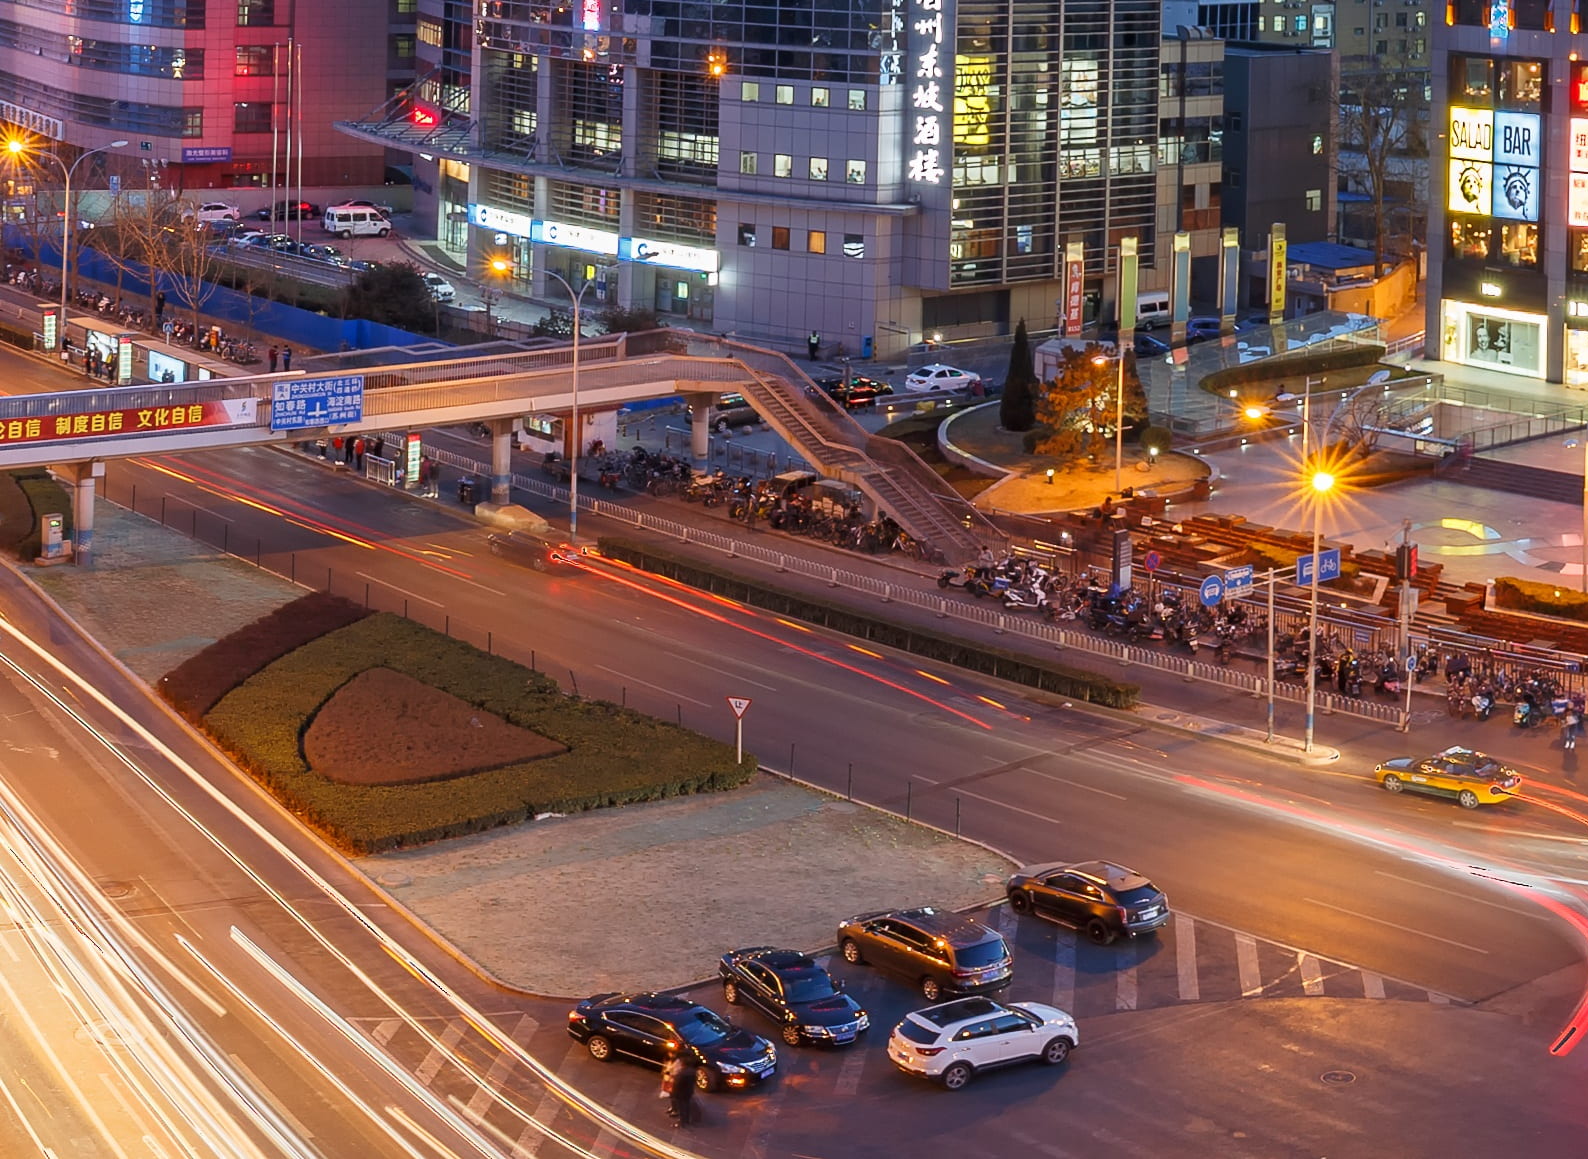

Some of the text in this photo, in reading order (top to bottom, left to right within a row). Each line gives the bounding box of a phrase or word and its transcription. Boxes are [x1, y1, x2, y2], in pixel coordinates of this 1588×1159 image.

[1452, 120, 1491, 150] SALAD
[1503, 125, 1531, 156] BAR
[56, 412, 123, 436] 制度自信
[137, 404, 204, 428] 文化自信
